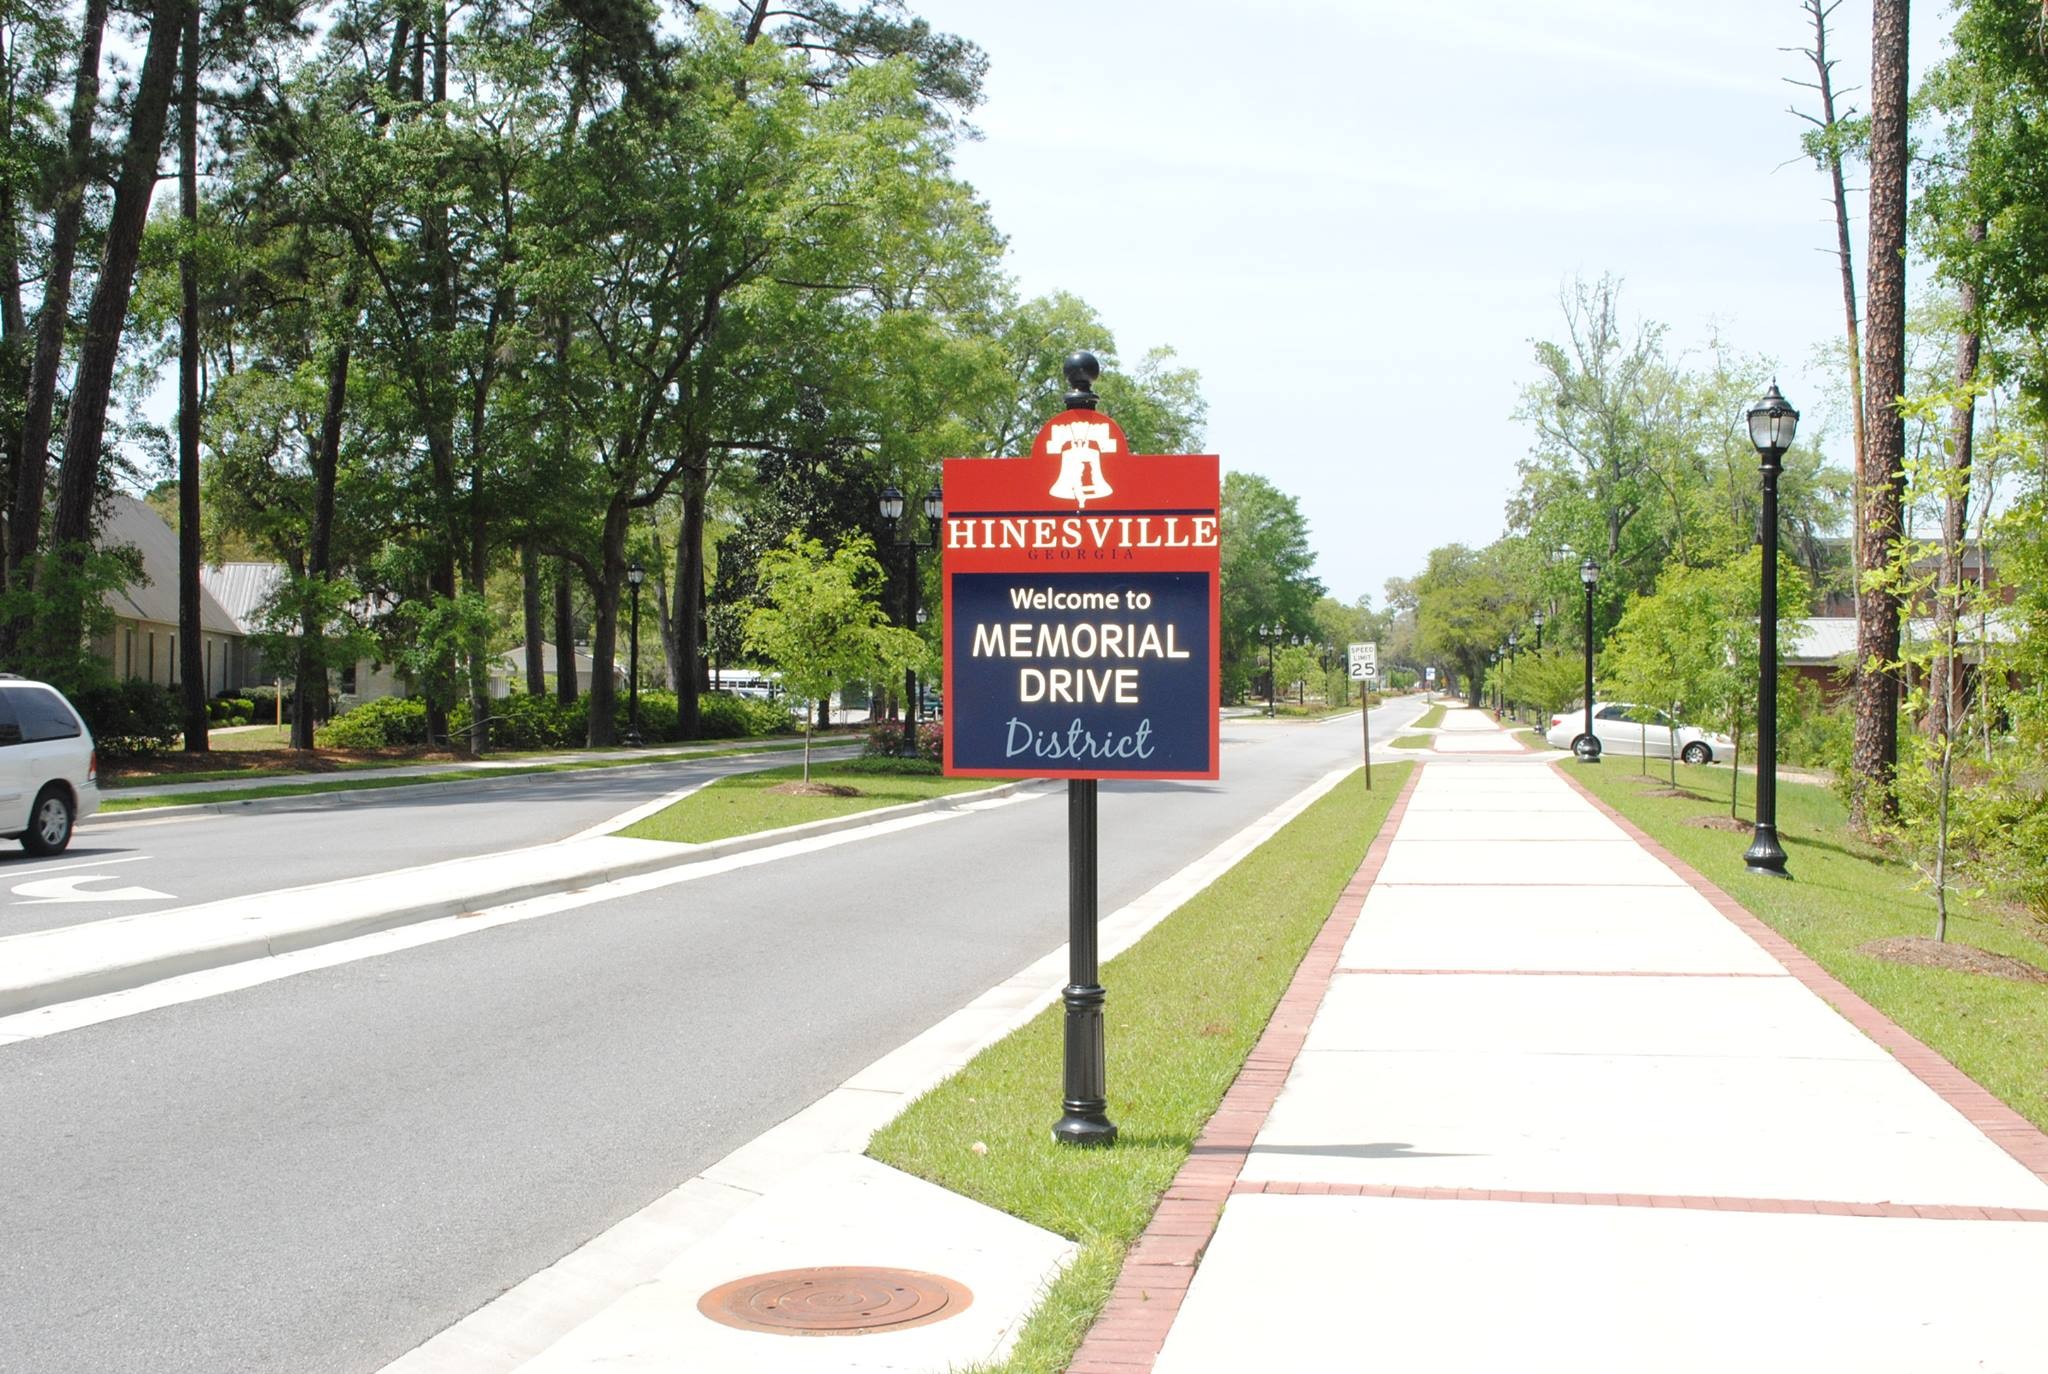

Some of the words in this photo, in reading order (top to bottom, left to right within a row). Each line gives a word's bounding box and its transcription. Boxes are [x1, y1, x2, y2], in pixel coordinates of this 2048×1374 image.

[946, 517, 1218, 549] HINESVILLE
[1028, 548, 1135, 561] GEORGIA
[1010, 587, 1119, 610] Welcome
[1126, 590, 1151, 610] to
[972, 623, 1190, 659] MEMORIAL
[1352, 663, 1375, 676] 25
[1020, 669, 1139, 704] DRIVE
[1005, 716, 1155, 760] District
